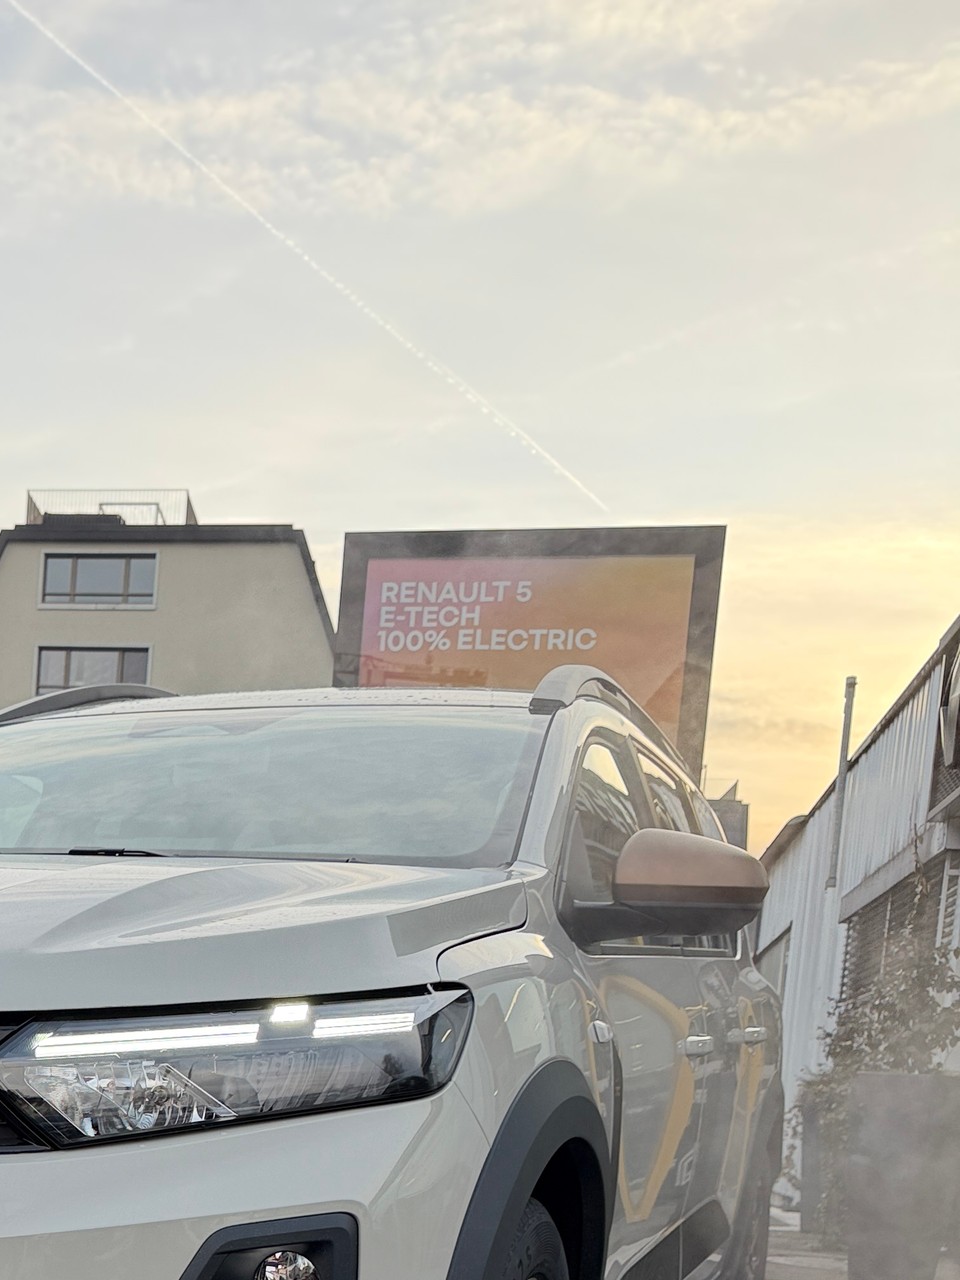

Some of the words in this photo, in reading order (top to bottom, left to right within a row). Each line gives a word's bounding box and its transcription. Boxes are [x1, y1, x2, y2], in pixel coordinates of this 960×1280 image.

[381, 581, 511, 603] RENAULT
[516, 581, 532, 602] 5
[380, 605, 480, 627] E-TECH
[377, 630, 451, 652] 100%
[457, 628, 597, 650] ELECTRIC
